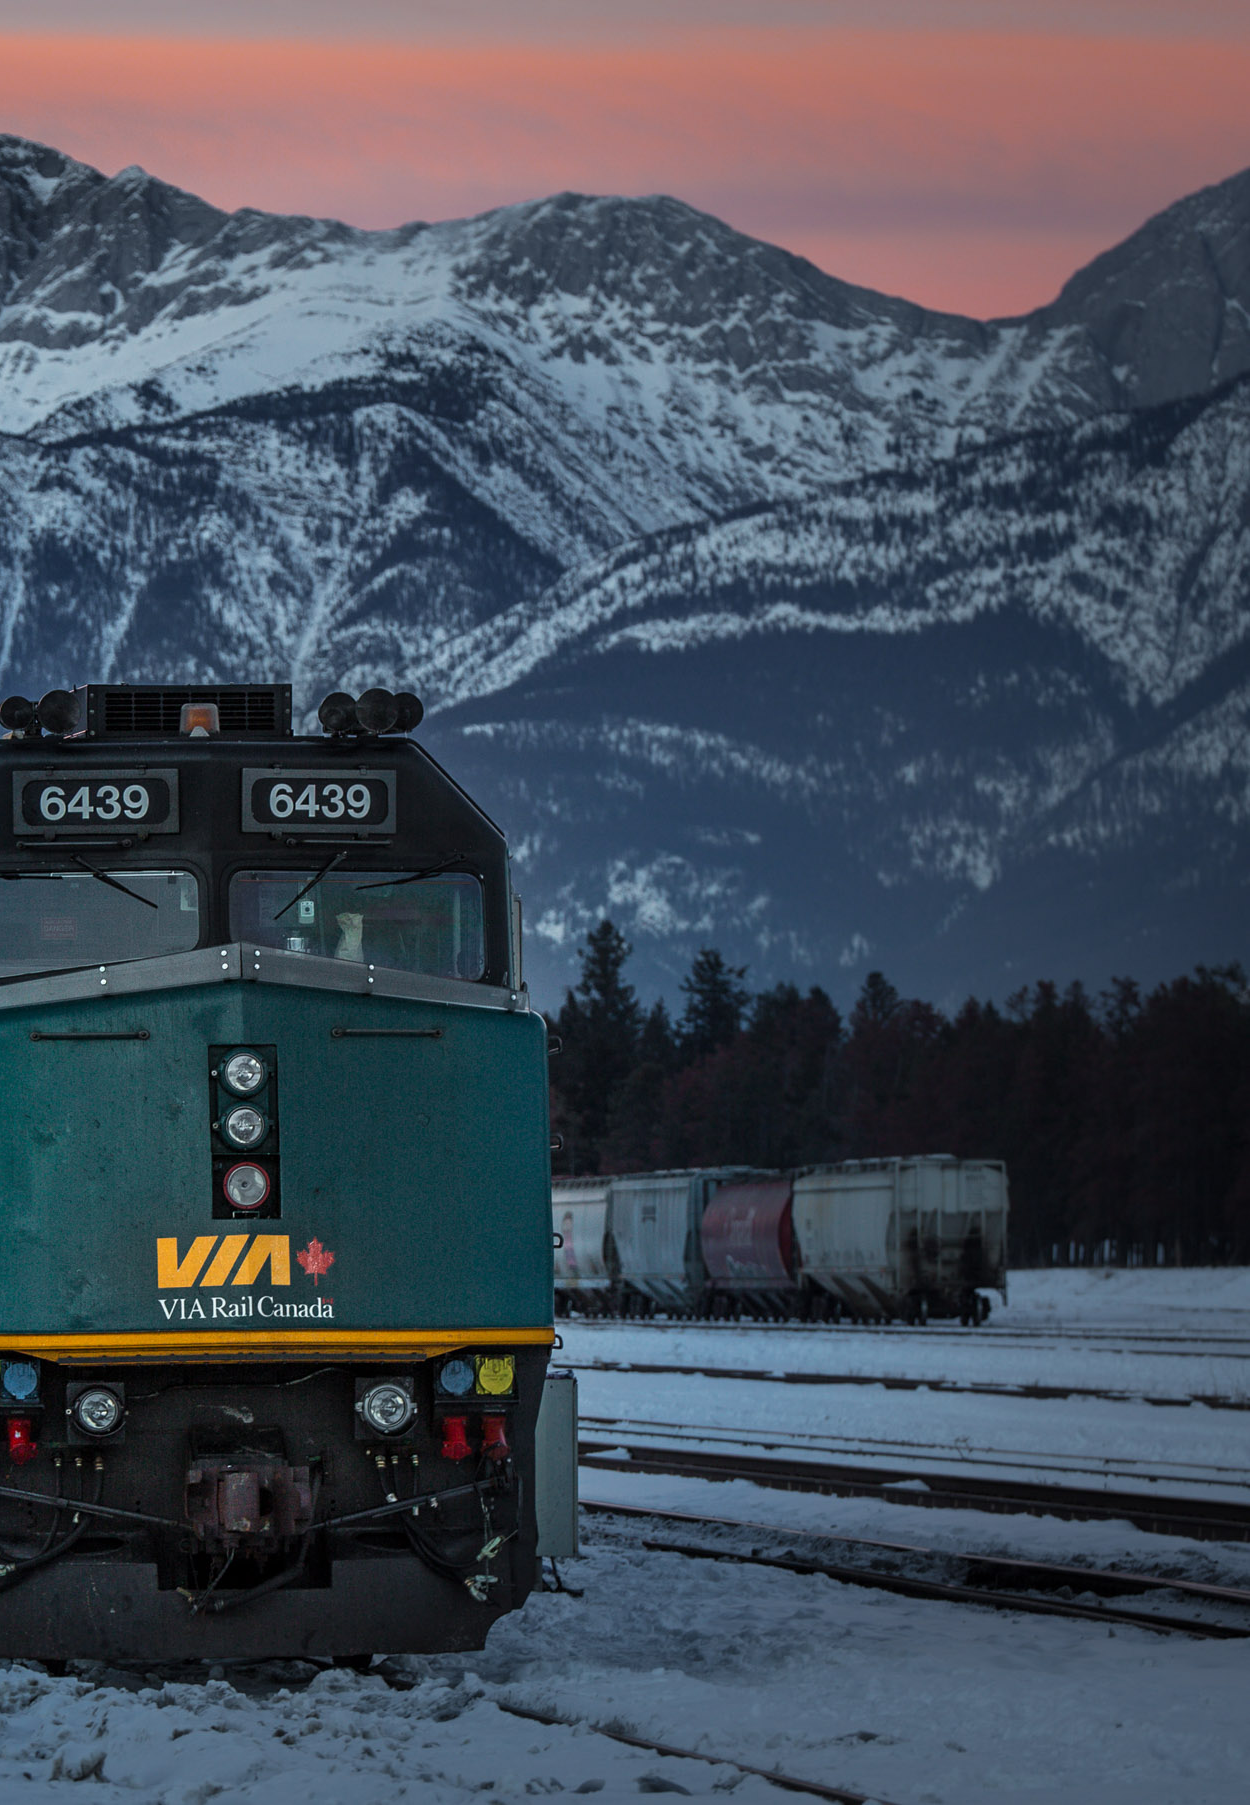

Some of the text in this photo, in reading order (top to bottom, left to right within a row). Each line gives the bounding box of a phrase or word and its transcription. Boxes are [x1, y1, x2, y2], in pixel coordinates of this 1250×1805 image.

[40, 784, 150, 821] 6439
[269, 783, 371, 819] 6439
[157, 1234, 291, 1288] VIA
[158, 1295, 335, 1320] VIA Rail Canada
